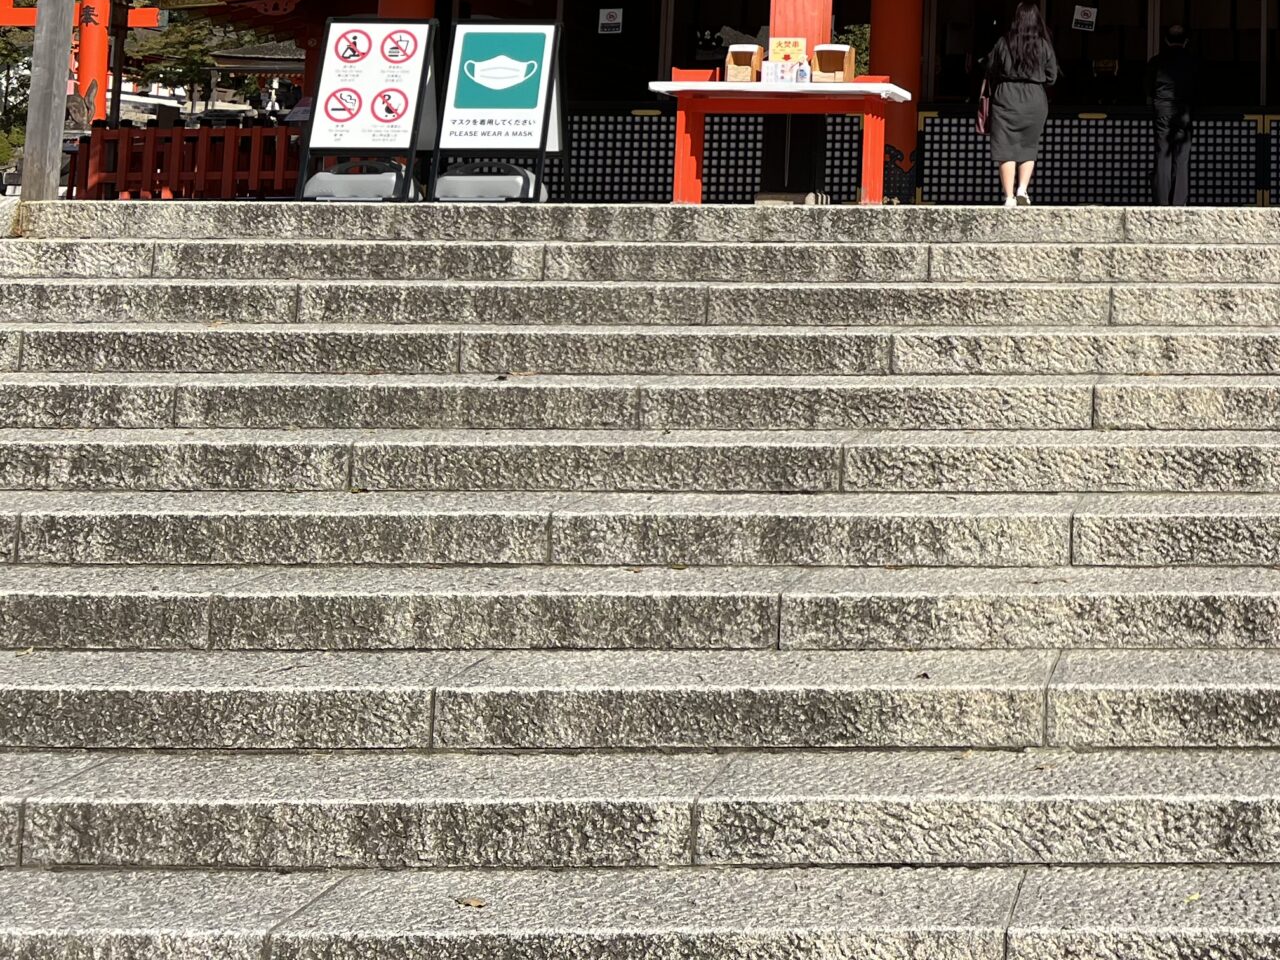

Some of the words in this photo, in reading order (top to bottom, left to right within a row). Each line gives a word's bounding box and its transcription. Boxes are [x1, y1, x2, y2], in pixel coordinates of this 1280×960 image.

[450, 118, 536, 126] マスクを着用してください
